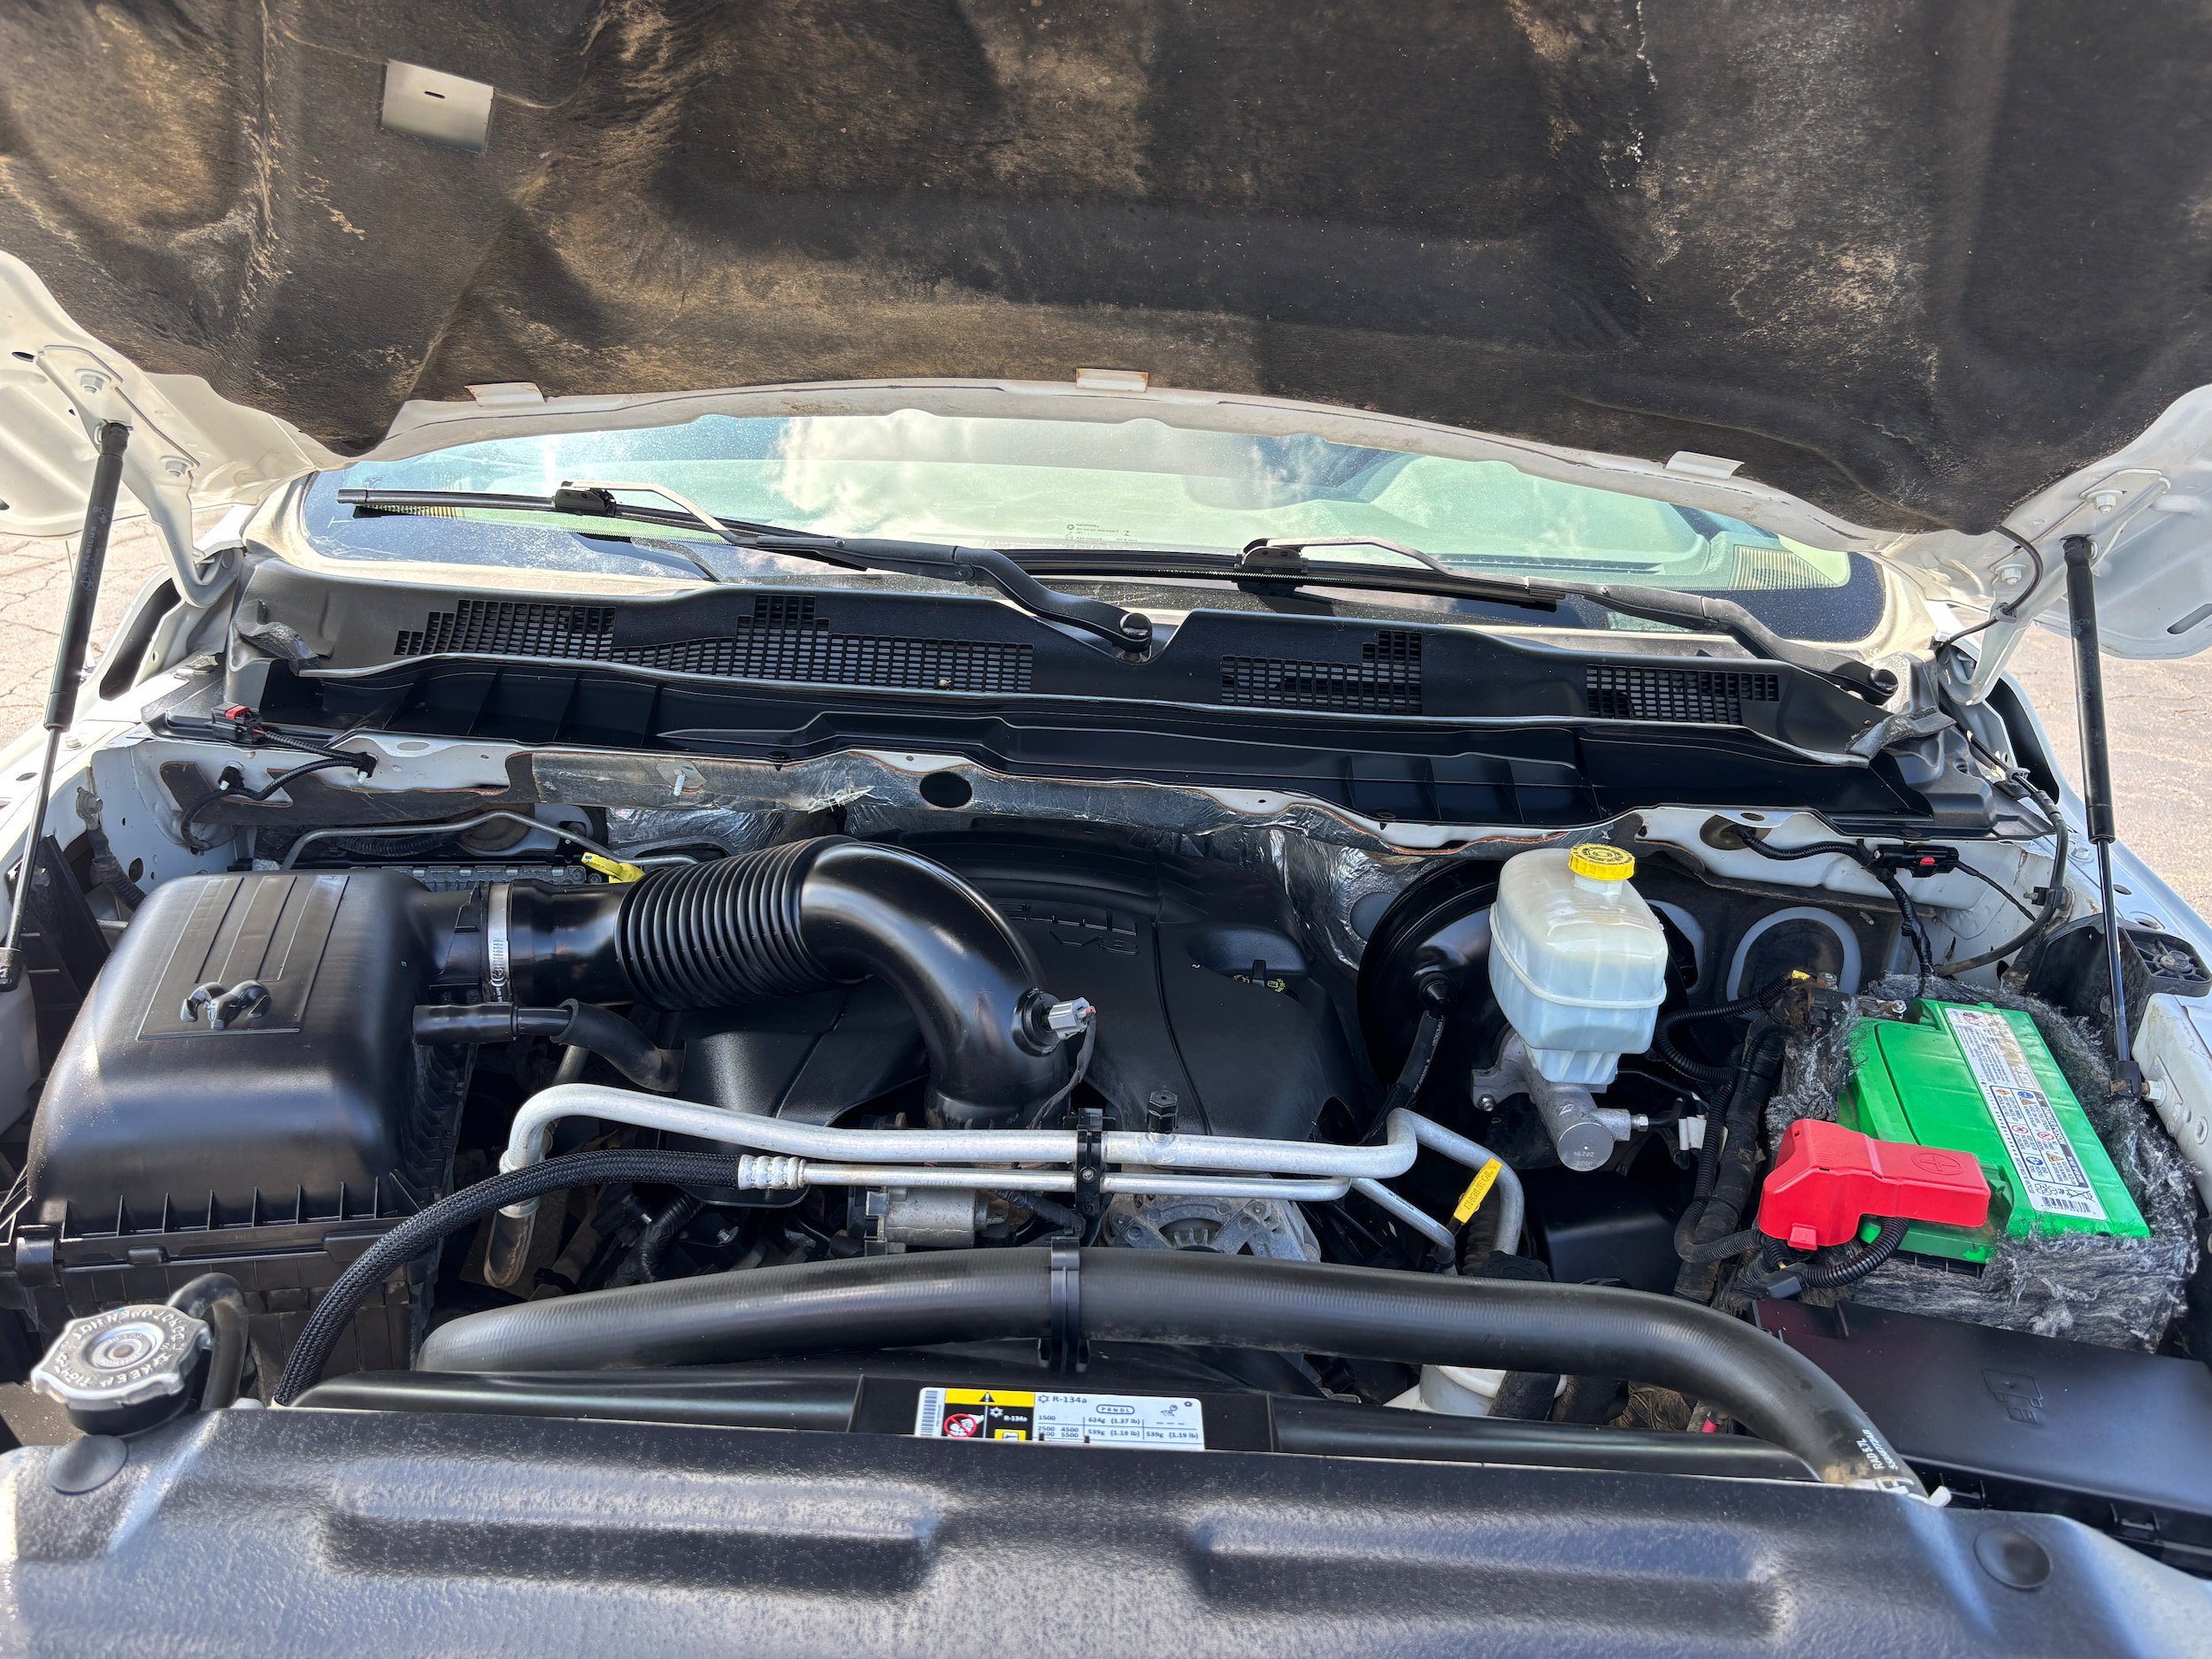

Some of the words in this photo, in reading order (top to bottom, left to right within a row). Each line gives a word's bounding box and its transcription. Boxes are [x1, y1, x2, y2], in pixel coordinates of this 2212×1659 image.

[1463, 1179, 1486, 1210] ENGINE
[1481, 1170, 1494, 1182] OIL
[1866, 1453, 1885, 1470] RAD
